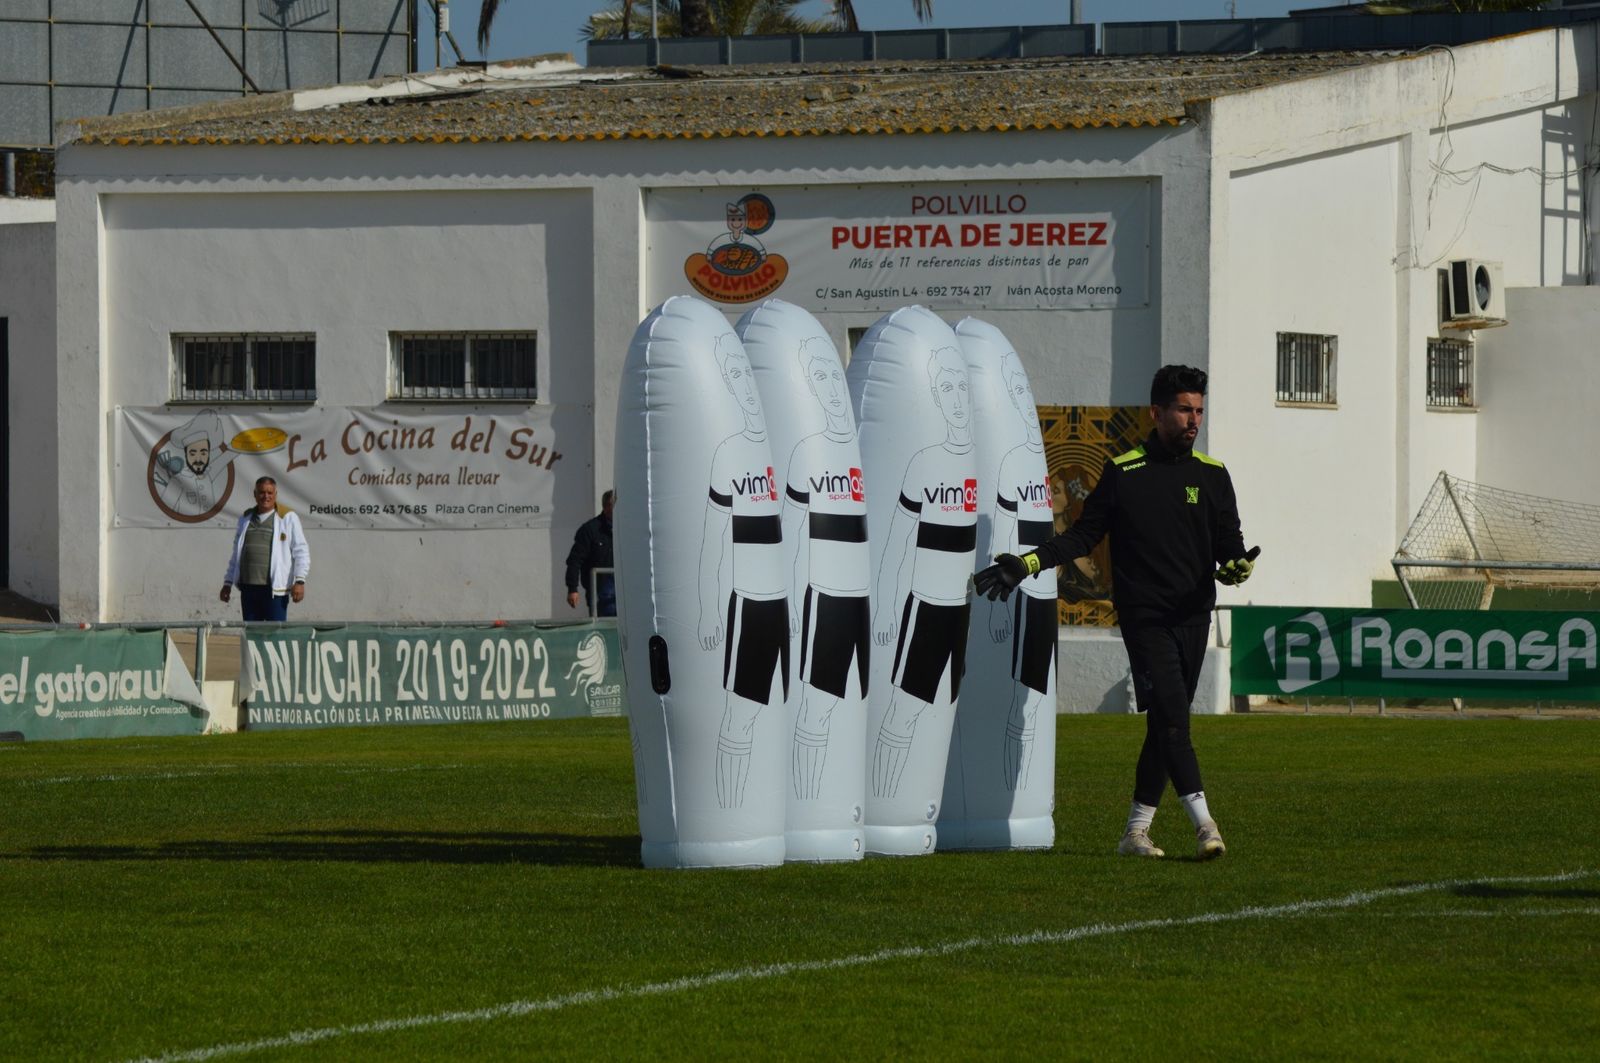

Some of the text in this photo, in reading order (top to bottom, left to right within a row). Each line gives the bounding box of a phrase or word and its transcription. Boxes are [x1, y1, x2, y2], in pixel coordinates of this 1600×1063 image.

[911, 194, 1027, 215] POLVILLO
[832, 222, 1107, 249] PUERTA DE JEREZ
[849, 257, 873, 269] Más
[880, 256, 893, 269] de
[917, 256, 981, 268] referencias
[987, 254, 1041, 267] distintas
[1047, 254, 1061, 267] de
[1067, 257, 1089, 269] pan
[697, 263, 777, 291] POLVILLO
[815, 287, 829, 299] C/
[830, 288, 852, 298] San
[855, 287, 900, 300] Agustín
[926, 286, 947, 297] 692
[951, 286, 970, 296] 734
[973, 285, 992, 296] 217
[1007, 285, 1031, 296] Iván
[1034, 285, 1074, 296] Acosta
[1076, 284, 1122, 295] Moreno
[286, 416, 563, 472] La Cocina del Sur
[348, 466, 500, 490] Comidas para llevar
[309, 503, 540, 515] Pedidos: 692 43 76 85 Plaza Gran Cinema
[941, 504, 964, 512] sport
[396, 637, 556, 701] 2019-2022
[0, 656, 29, 704] el
[143, 705, 148, 716] y
[347, 707, 362, 723] DE
[365, 707, 380, 722] LA
[385, 705, 442, 722] PRIMERA
[443, 704, 483, 721] VUELTA
[486, 704, 499, 720] AL
[503, 702, 550, 720] MUNDO
